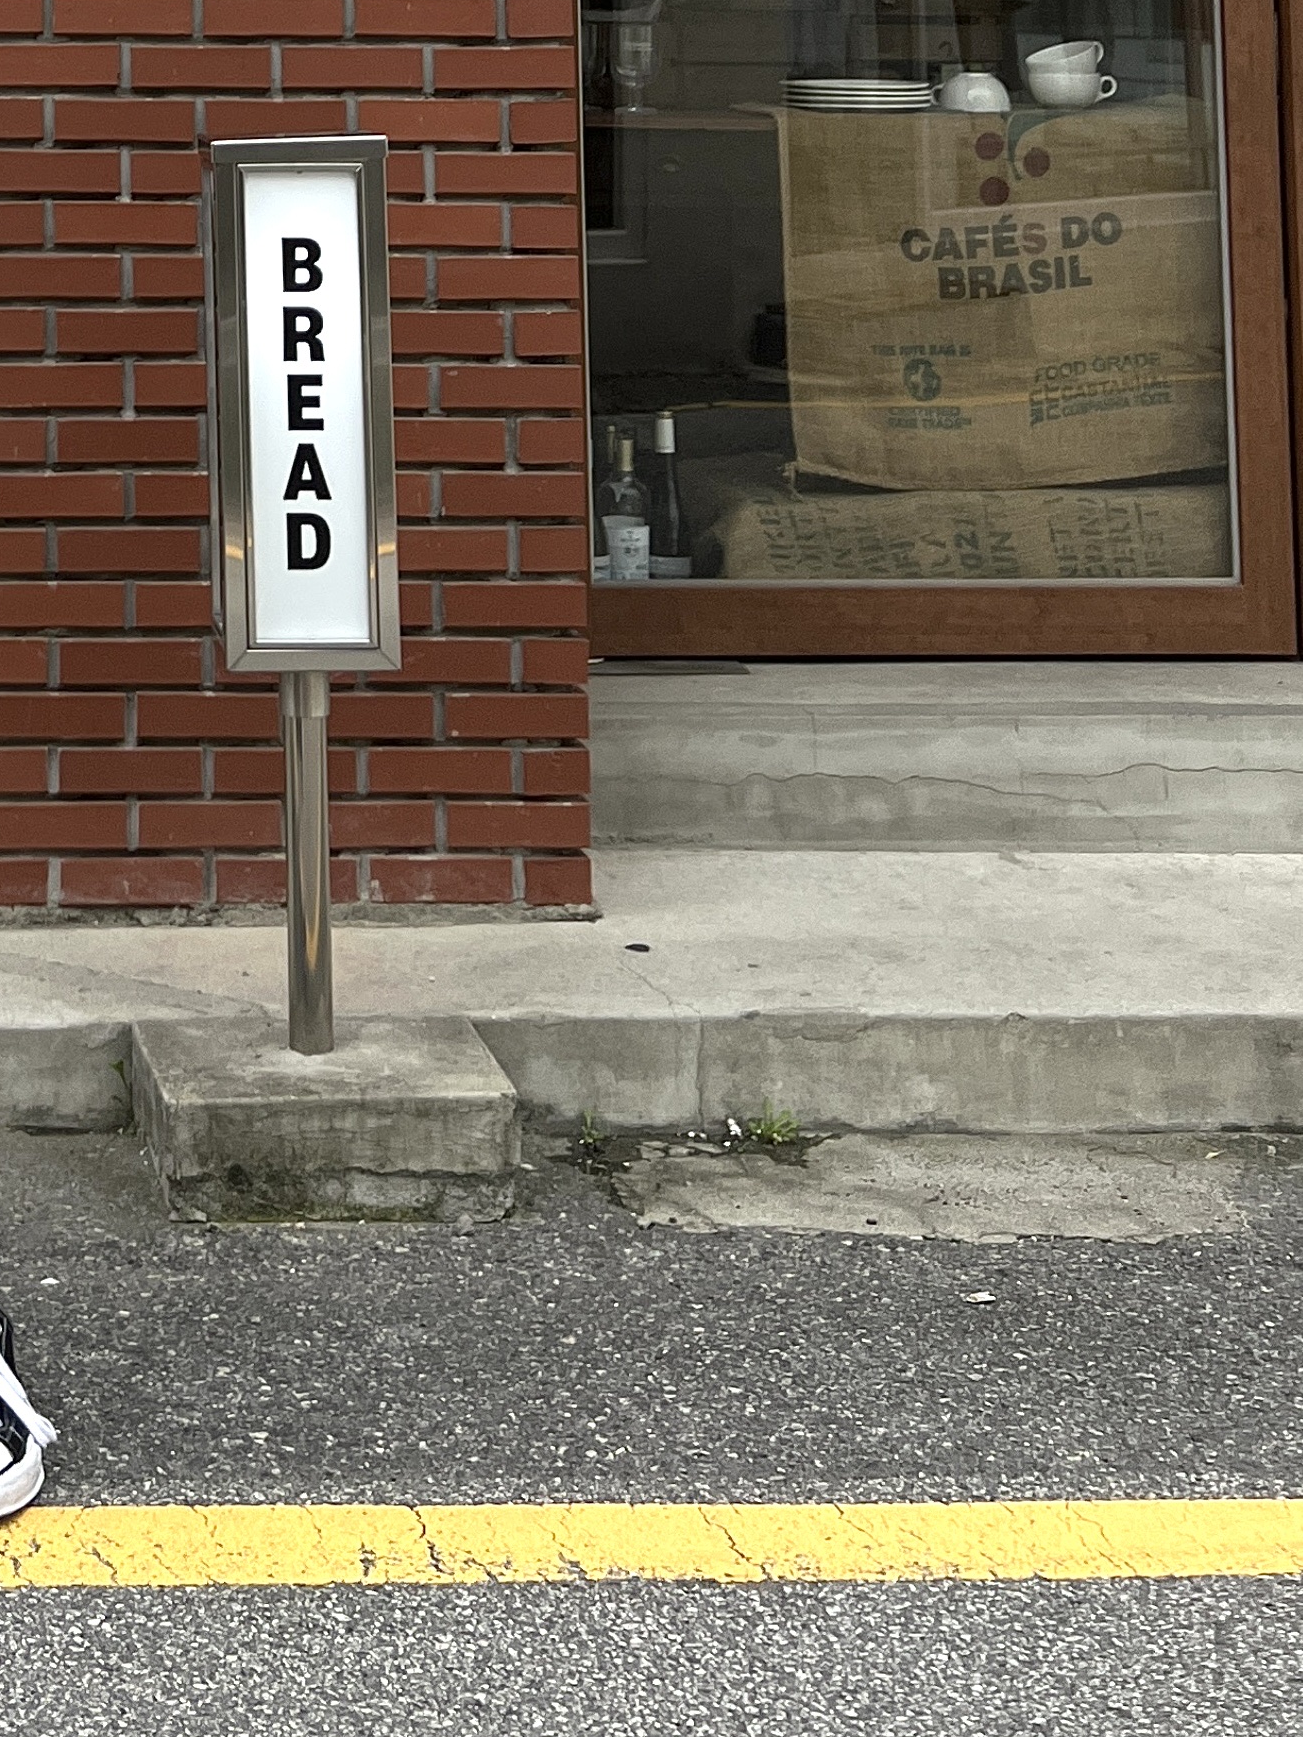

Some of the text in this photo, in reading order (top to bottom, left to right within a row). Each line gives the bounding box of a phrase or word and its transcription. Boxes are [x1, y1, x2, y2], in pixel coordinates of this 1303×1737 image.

[900, 211, 1123, 263] CAFÉS DO
[938, 254, 1094, 300] BRASIL
[1034, 351, 1161, 384] FOOD GRADE
[281, 237, 332, 571] BREAD
